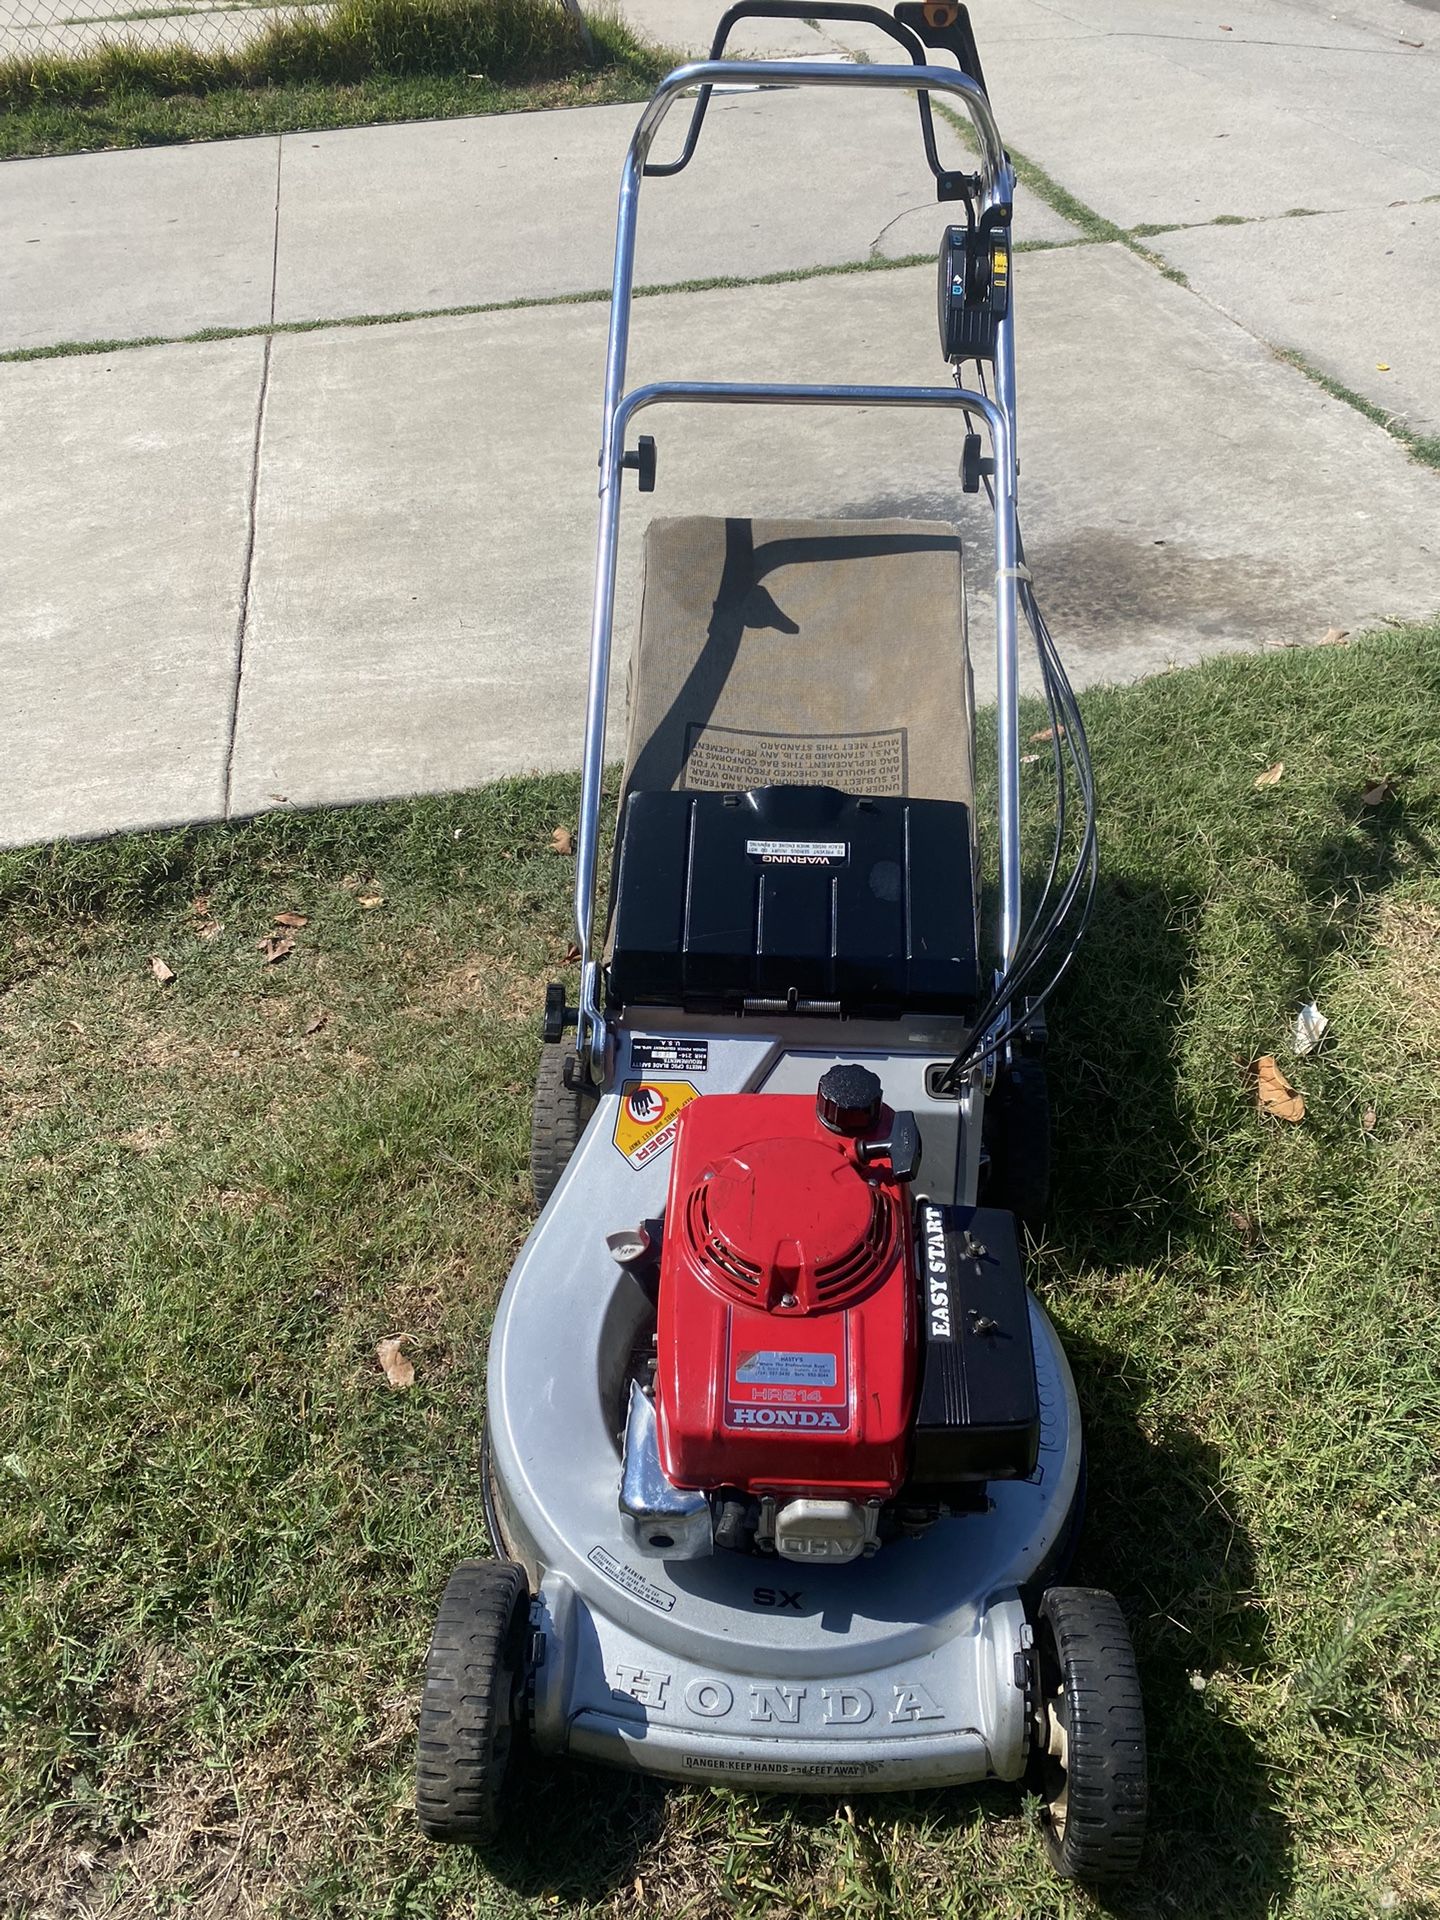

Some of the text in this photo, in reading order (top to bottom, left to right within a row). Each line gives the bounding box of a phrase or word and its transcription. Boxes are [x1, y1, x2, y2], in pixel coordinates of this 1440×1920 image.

[872, 739, 899, 748] MUST
[691, 750, 702, 758] TO
[706, 752, 757, 765] CONFORMS
[815, 751, 865, 759] STANDARD
[691, 759, 707, 768] FOR
[880, 756, 899, 765] BAG
[711, 763, 770, 776] FREQUENTLY
[837, 768, 876, 777] SHOULD
[879, 765, 899, 774] AND
[722, 773, 742, 781] AND
[746, 776, 823, 786] DETERIORATION
[844, 776, 887, 786] SUBJECT
[689, 776, 735, 789] MATERIAL
[866, 784, 899, 793] UNDER
[762, 856, 829, 864] WARNING
[636, 1123, 677, 1161] NGER
[926, 1207, 951, 1336] EASY START
[752, 1388, 822, 1402] HR214
[733, 1408, 841, 1427] HONDA
[624, 1565, 647, 1583] WARNING
[753, 1587, 803, 1610] SX
[611, 1664, 946, 1726] HONDA
[754, 1763, 788, 1773] HANDS
[810, 1766, 831, 1774] FEET
[834, 1766, 860, 1775] AWAY
